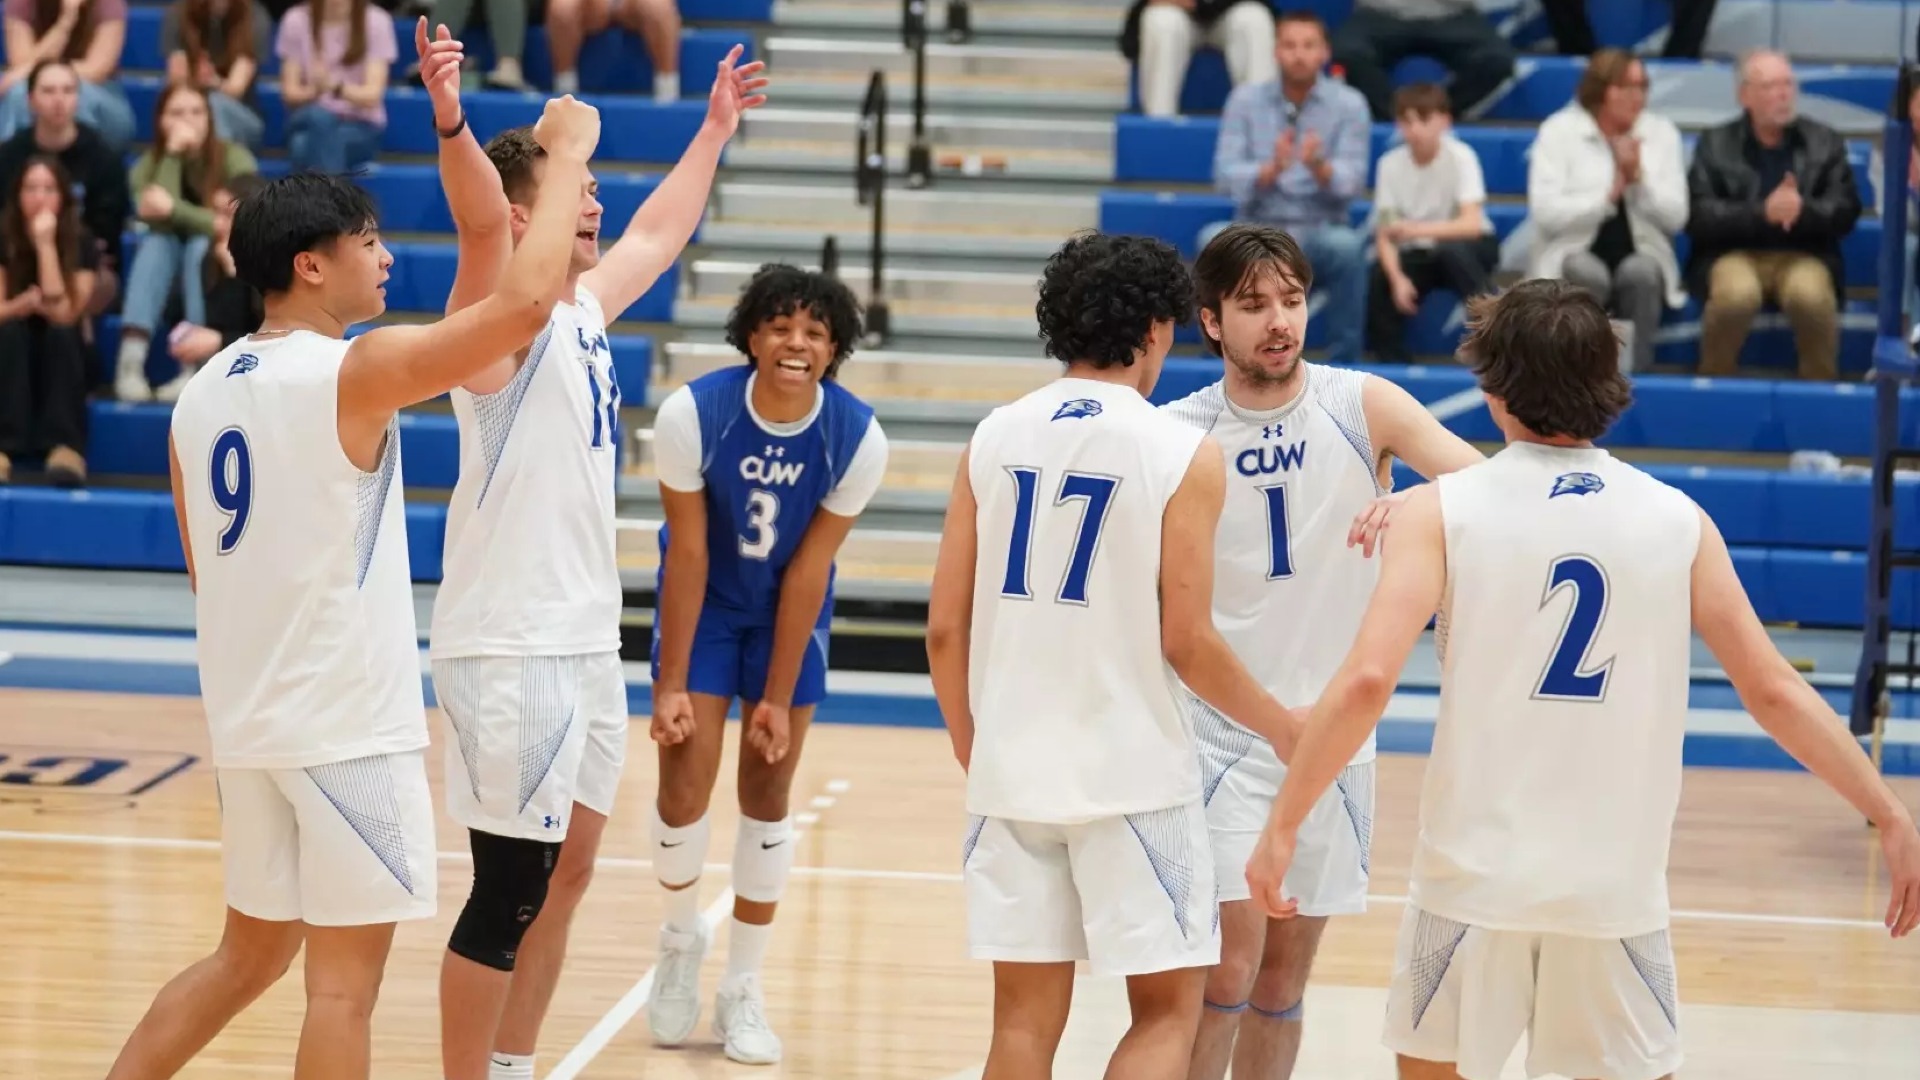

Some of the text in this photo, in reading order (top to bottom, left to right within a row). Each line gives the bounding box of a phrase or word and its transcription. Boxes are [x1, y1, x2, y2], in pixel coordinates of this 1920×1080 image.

[208, 424, 254, 556] 9
[739, 455, 805, 486] CUW
[1236, 440, 1306, 477] CUW
[738, 487, 780, 562] 3
[1000, 465, 1124, 608] 17
[1253, 481, 1297, 582] 1
[1528, 552, 1616, 703] 2
